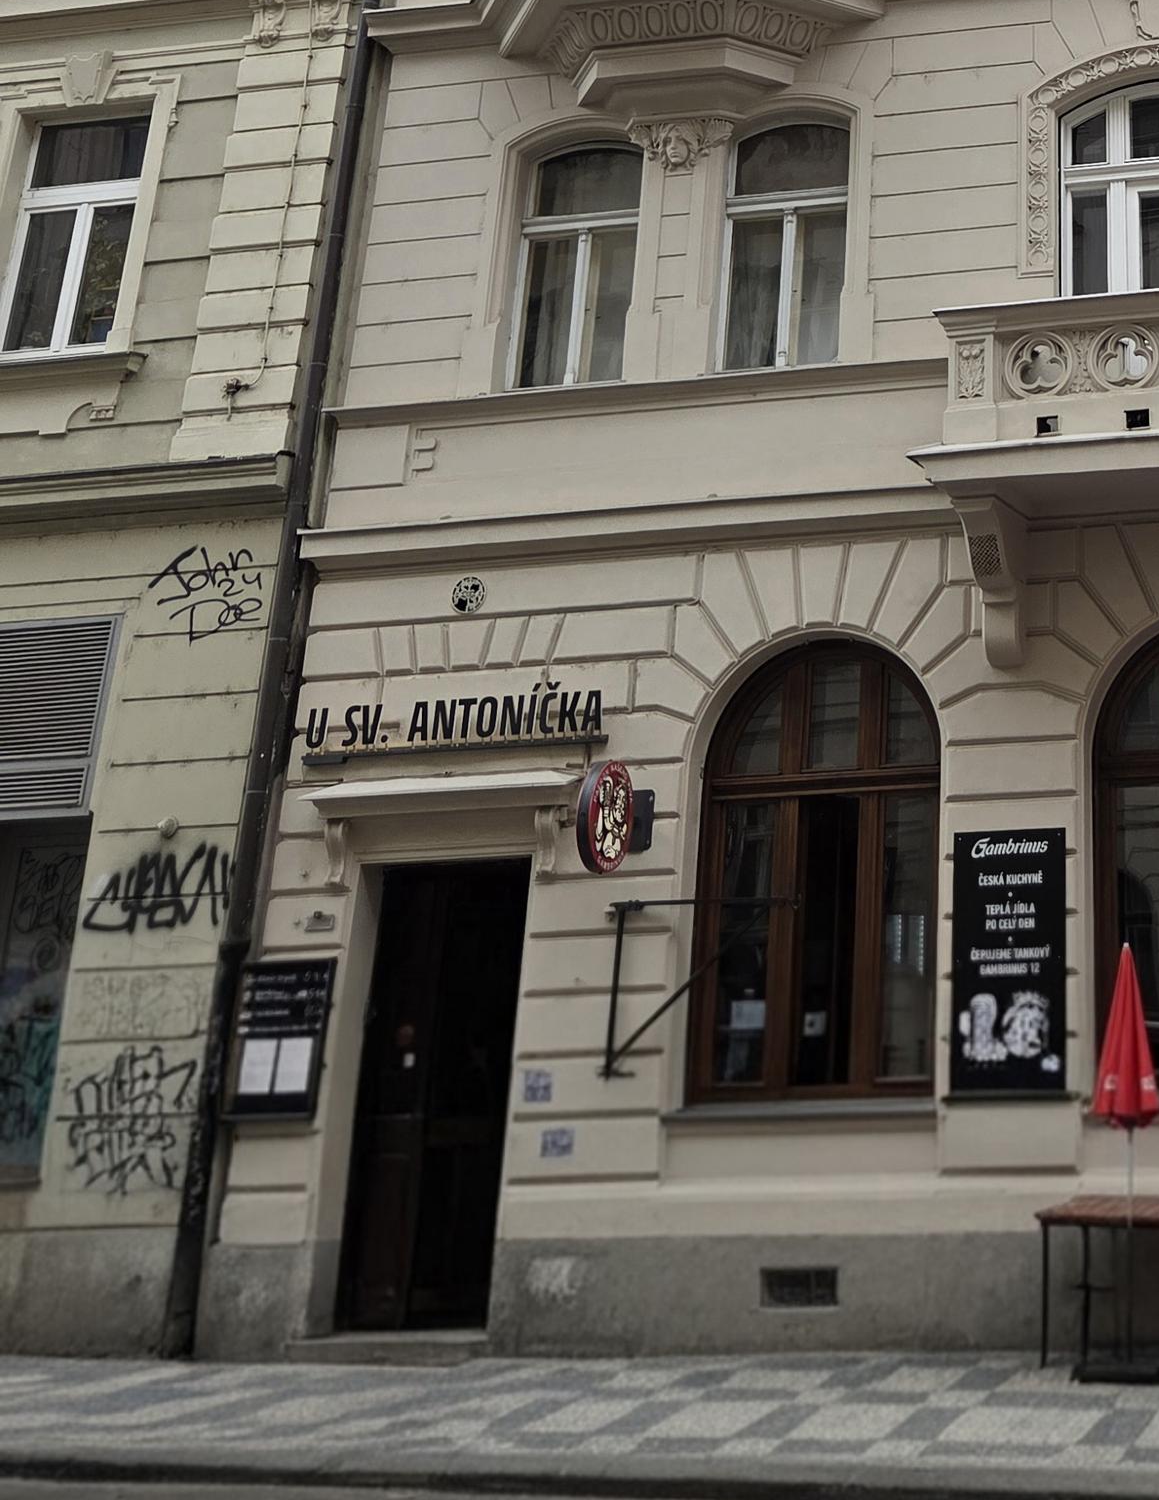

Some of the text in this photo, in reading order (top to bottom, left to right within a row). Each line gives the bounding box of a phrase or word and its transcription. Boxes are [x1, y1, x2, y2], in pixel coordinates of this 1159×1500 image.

[305, 681, 602, 750] U SV. ANTONÍČKA
[970, 837, 1049, 859] Gambrinus
[978, 869, 1043, 886] ČESKÁ KUCHYNĚ
[985, 900, 1036, 916] TEPLÁ JÍDLA
[985, 915, 1035, 931] PO CELÝ DEN
